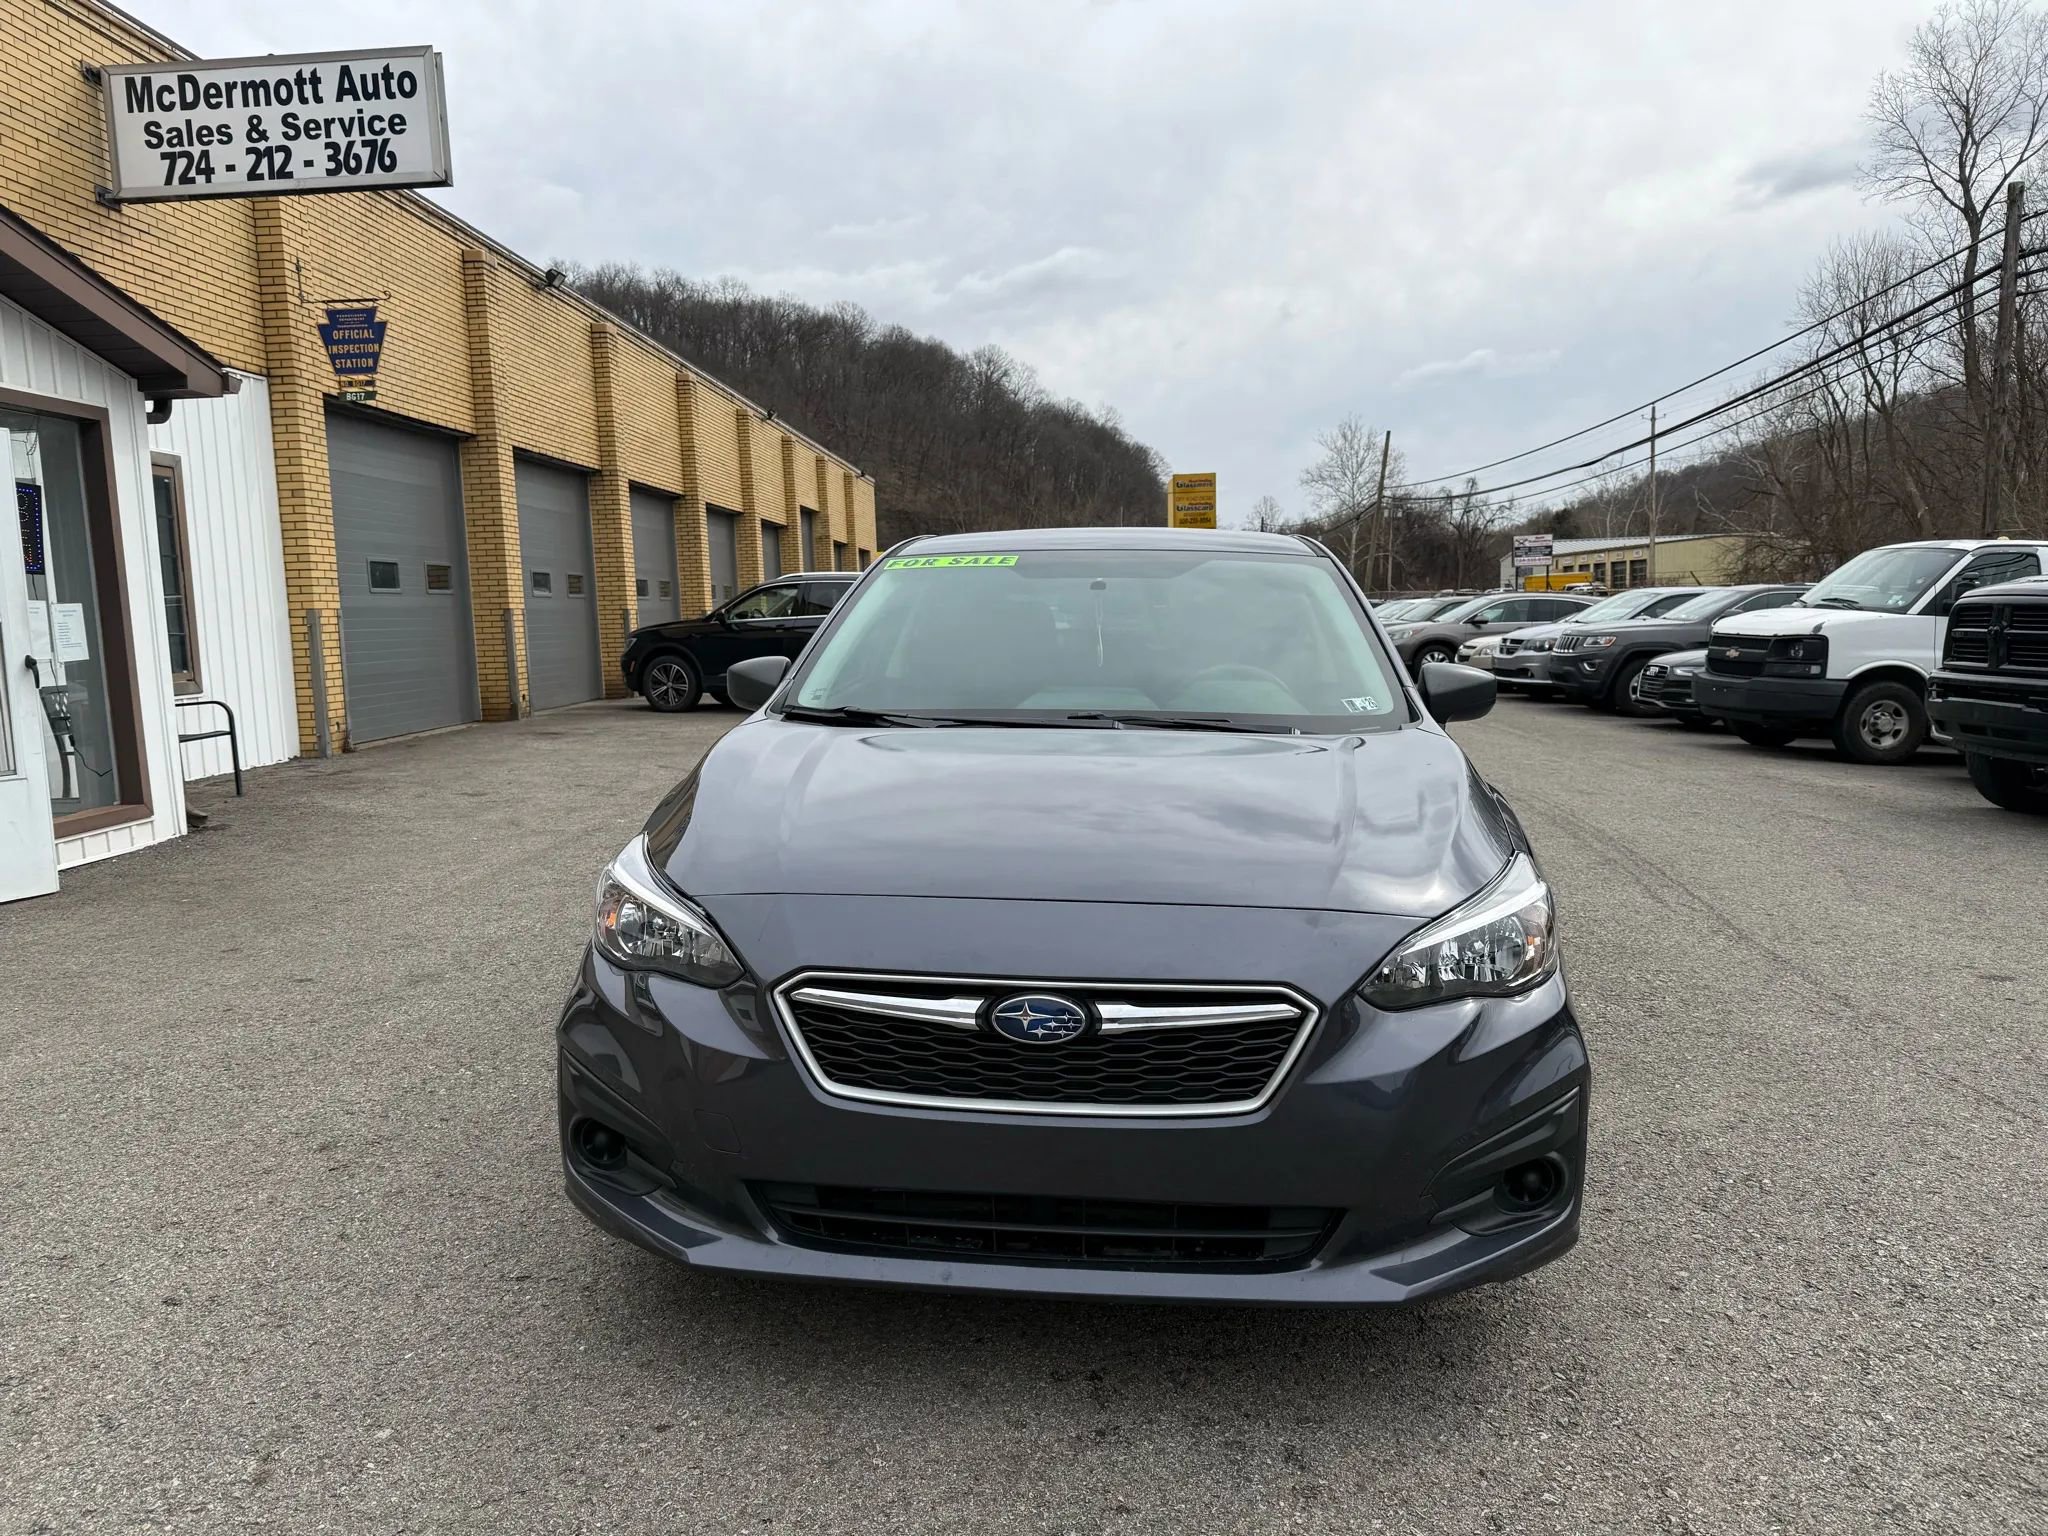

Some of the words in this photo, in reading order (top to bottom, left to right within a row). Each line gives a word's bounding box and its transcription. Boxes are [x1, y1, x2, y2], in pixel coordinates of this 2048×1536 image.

[124, 67, 323, 114] McDermott
[335, 62, 418, 103] Auto
[143, 119, 233, 150] Sales
[245, 114, 270, 143] &
[281, 108, 407, 141] Service
[160, 150, 215, 186] 724
[245, 145, 294, 181] 212
[324, 138, 397, 177] 3676
[332, 329, 375, 340] OFFICIAL
[328, 344, 379, 354] INSPECTION
[335, 358, 374, 369] STATION
[346, 392, 366, 400] BG17
[888, 559, 938, 568] FOR
[948, 557, 1013, 565] SALE
